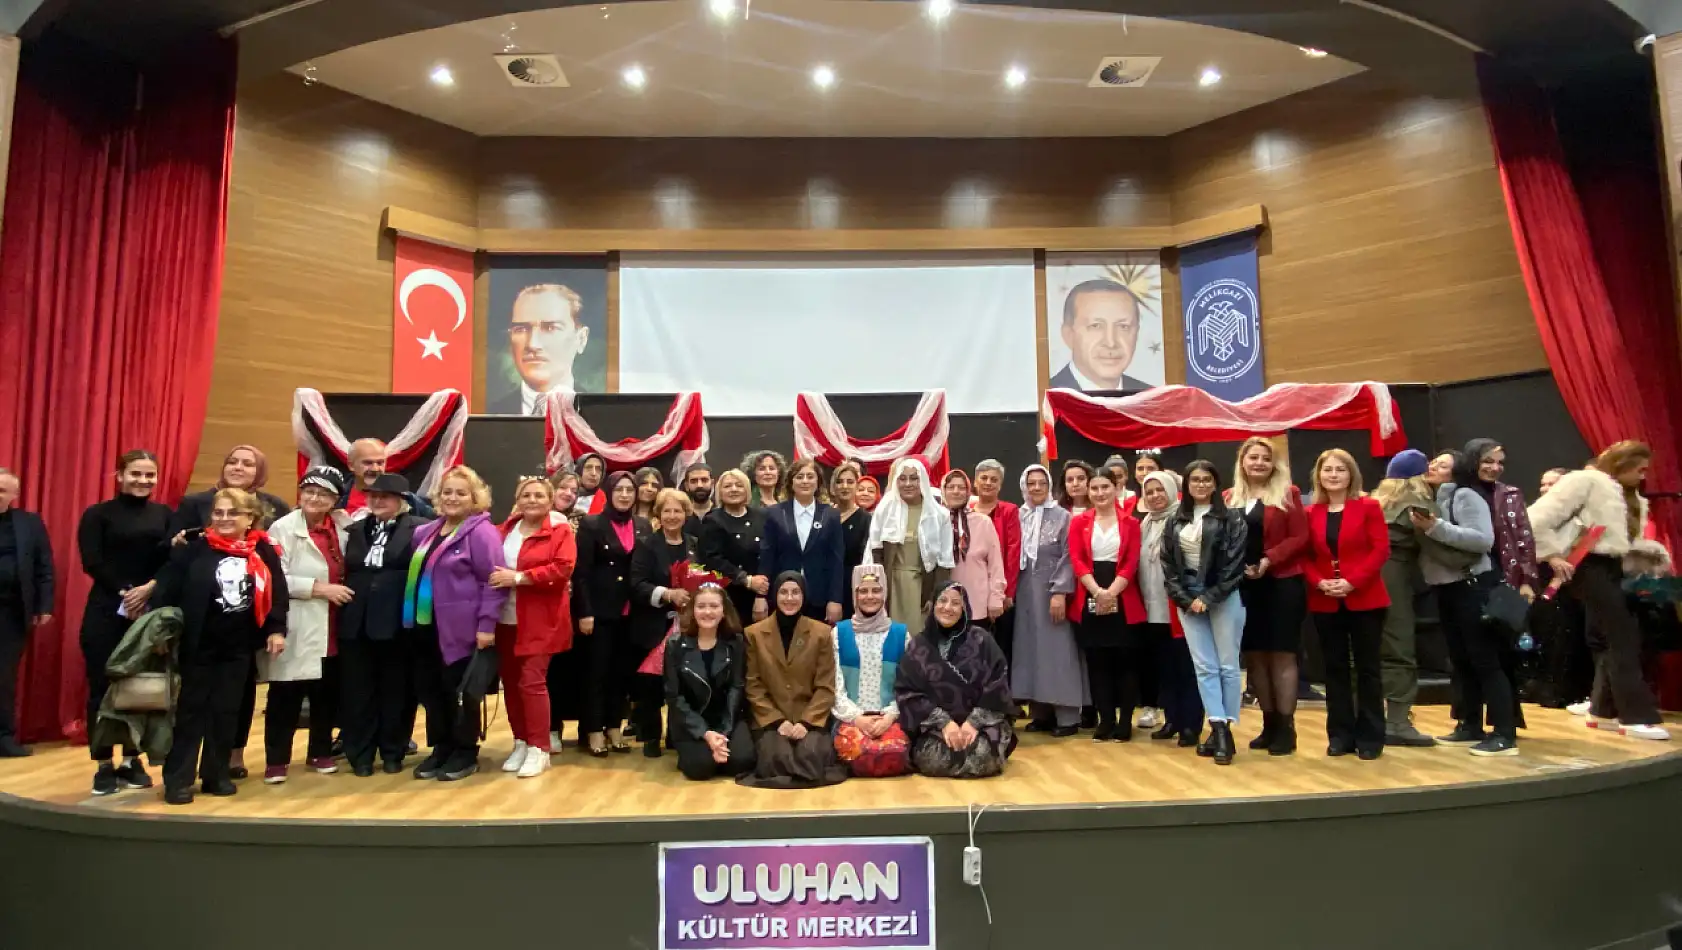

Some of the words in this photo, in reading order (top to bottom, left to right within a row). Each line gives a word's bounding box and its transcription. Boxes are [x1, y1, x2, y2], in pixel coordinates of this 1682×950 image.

[692, 861, 900, 904] ULUHAN
[678, 912, 789, 940] KÜLTÜR
[797, 910, 918, 939] MERKEZİ
